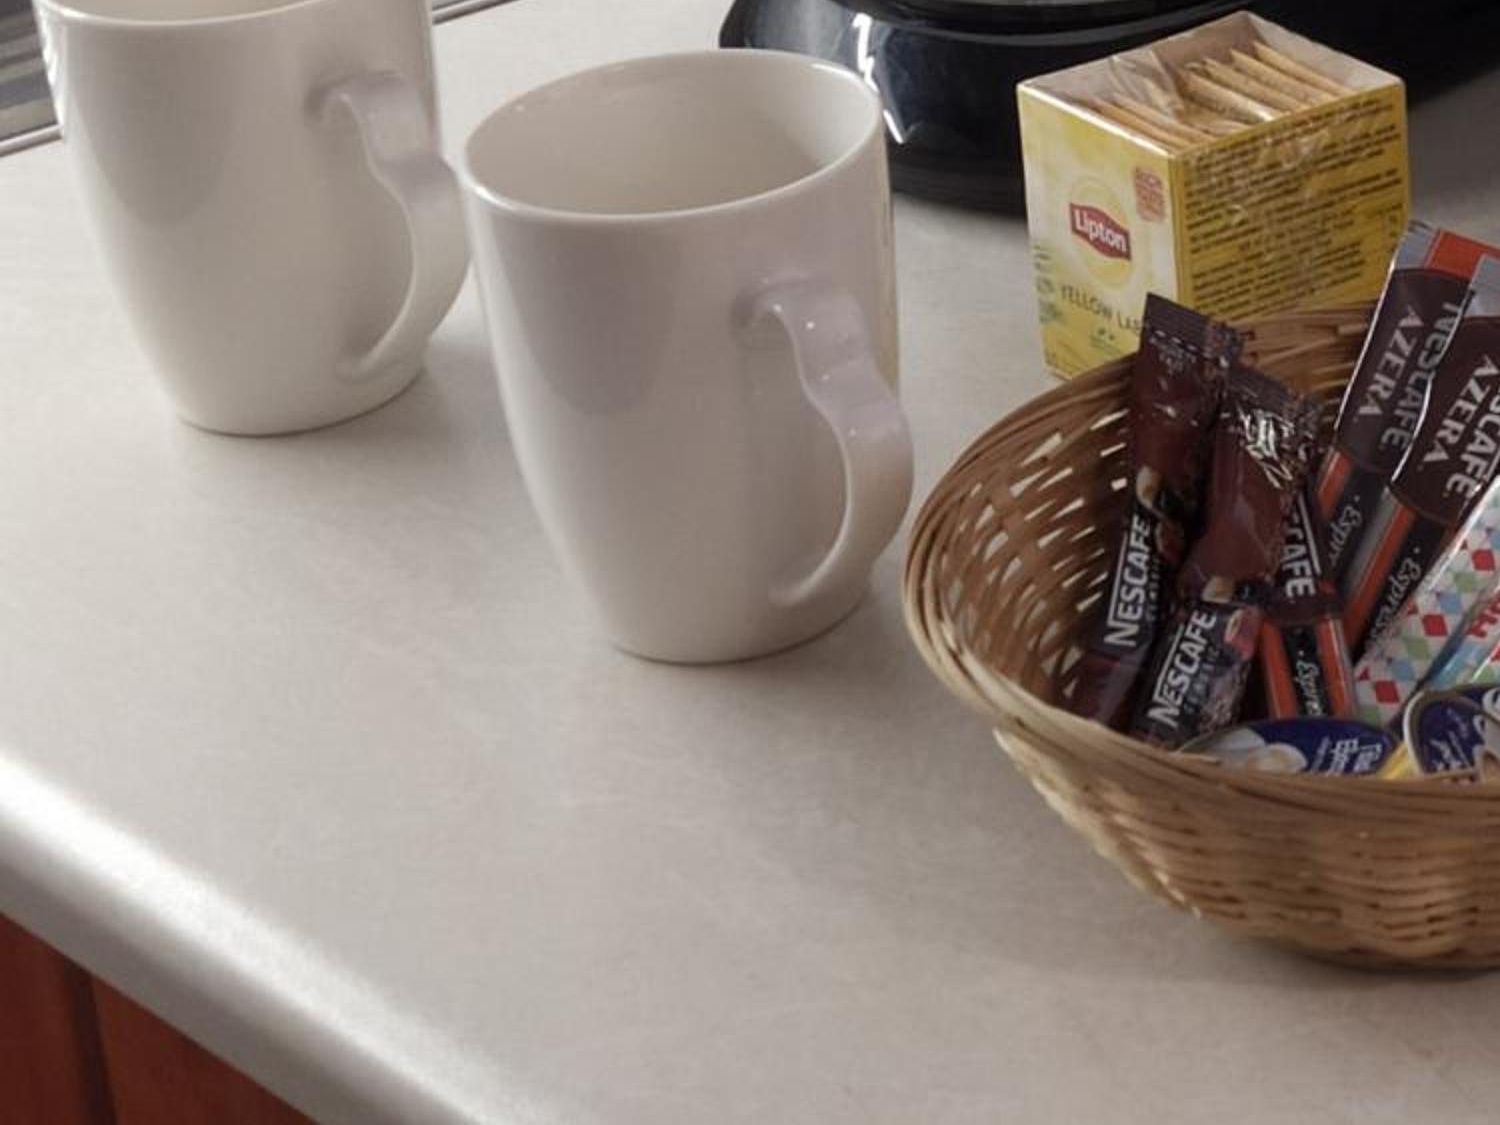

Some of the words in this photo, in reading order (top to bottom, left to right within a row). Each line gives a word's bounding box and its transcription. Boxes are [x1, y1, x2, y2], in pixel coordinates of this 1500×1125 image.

[1073, 207, 1127, 254] Lipton
[1358, 305, 1425, 419] AZERA
[1422, 355, 1500, 465] AZERA
